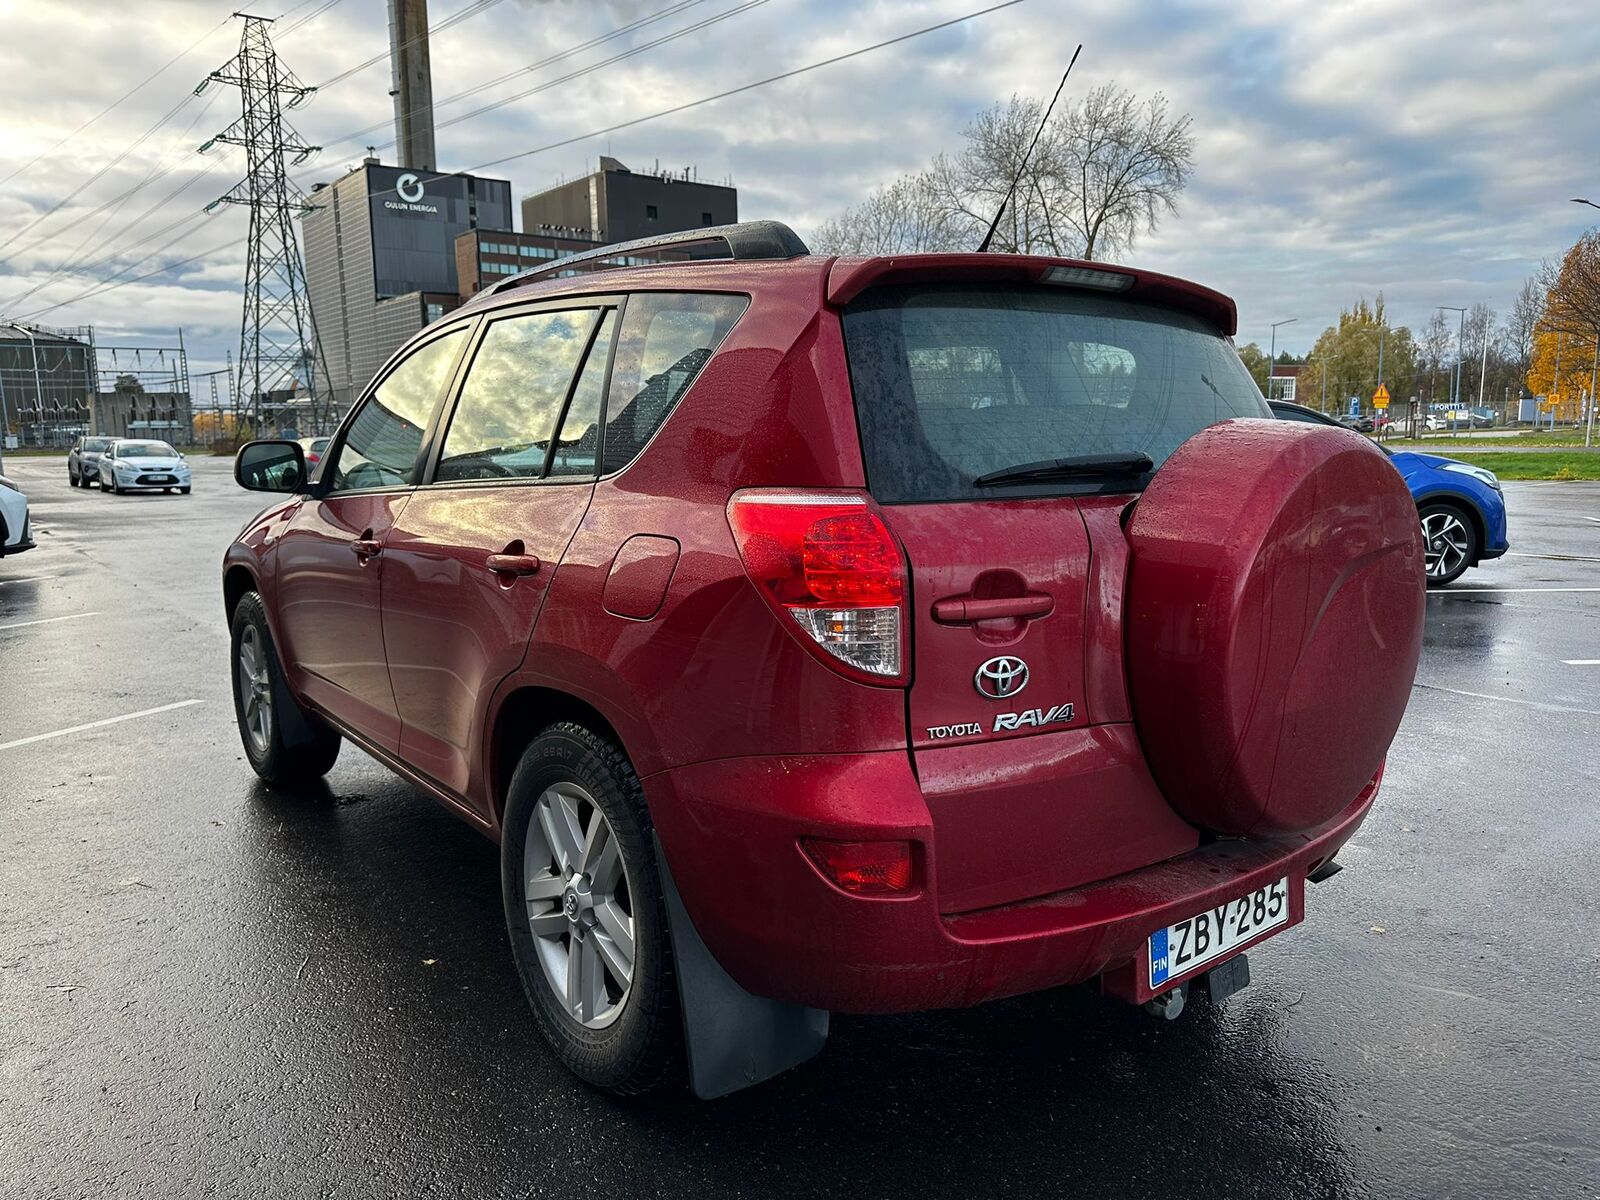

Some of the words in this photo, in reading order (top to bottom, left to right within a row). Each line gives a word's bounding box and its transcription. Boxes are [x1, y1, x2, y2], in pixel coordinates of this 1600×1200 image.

[927, 723, 982, 739] TOYOTA
[993, 703, 1075, 732] RAV4
[1175, 881, 1282, 966] ZBY-285
[1153, 956, 1167, 974] FIN
